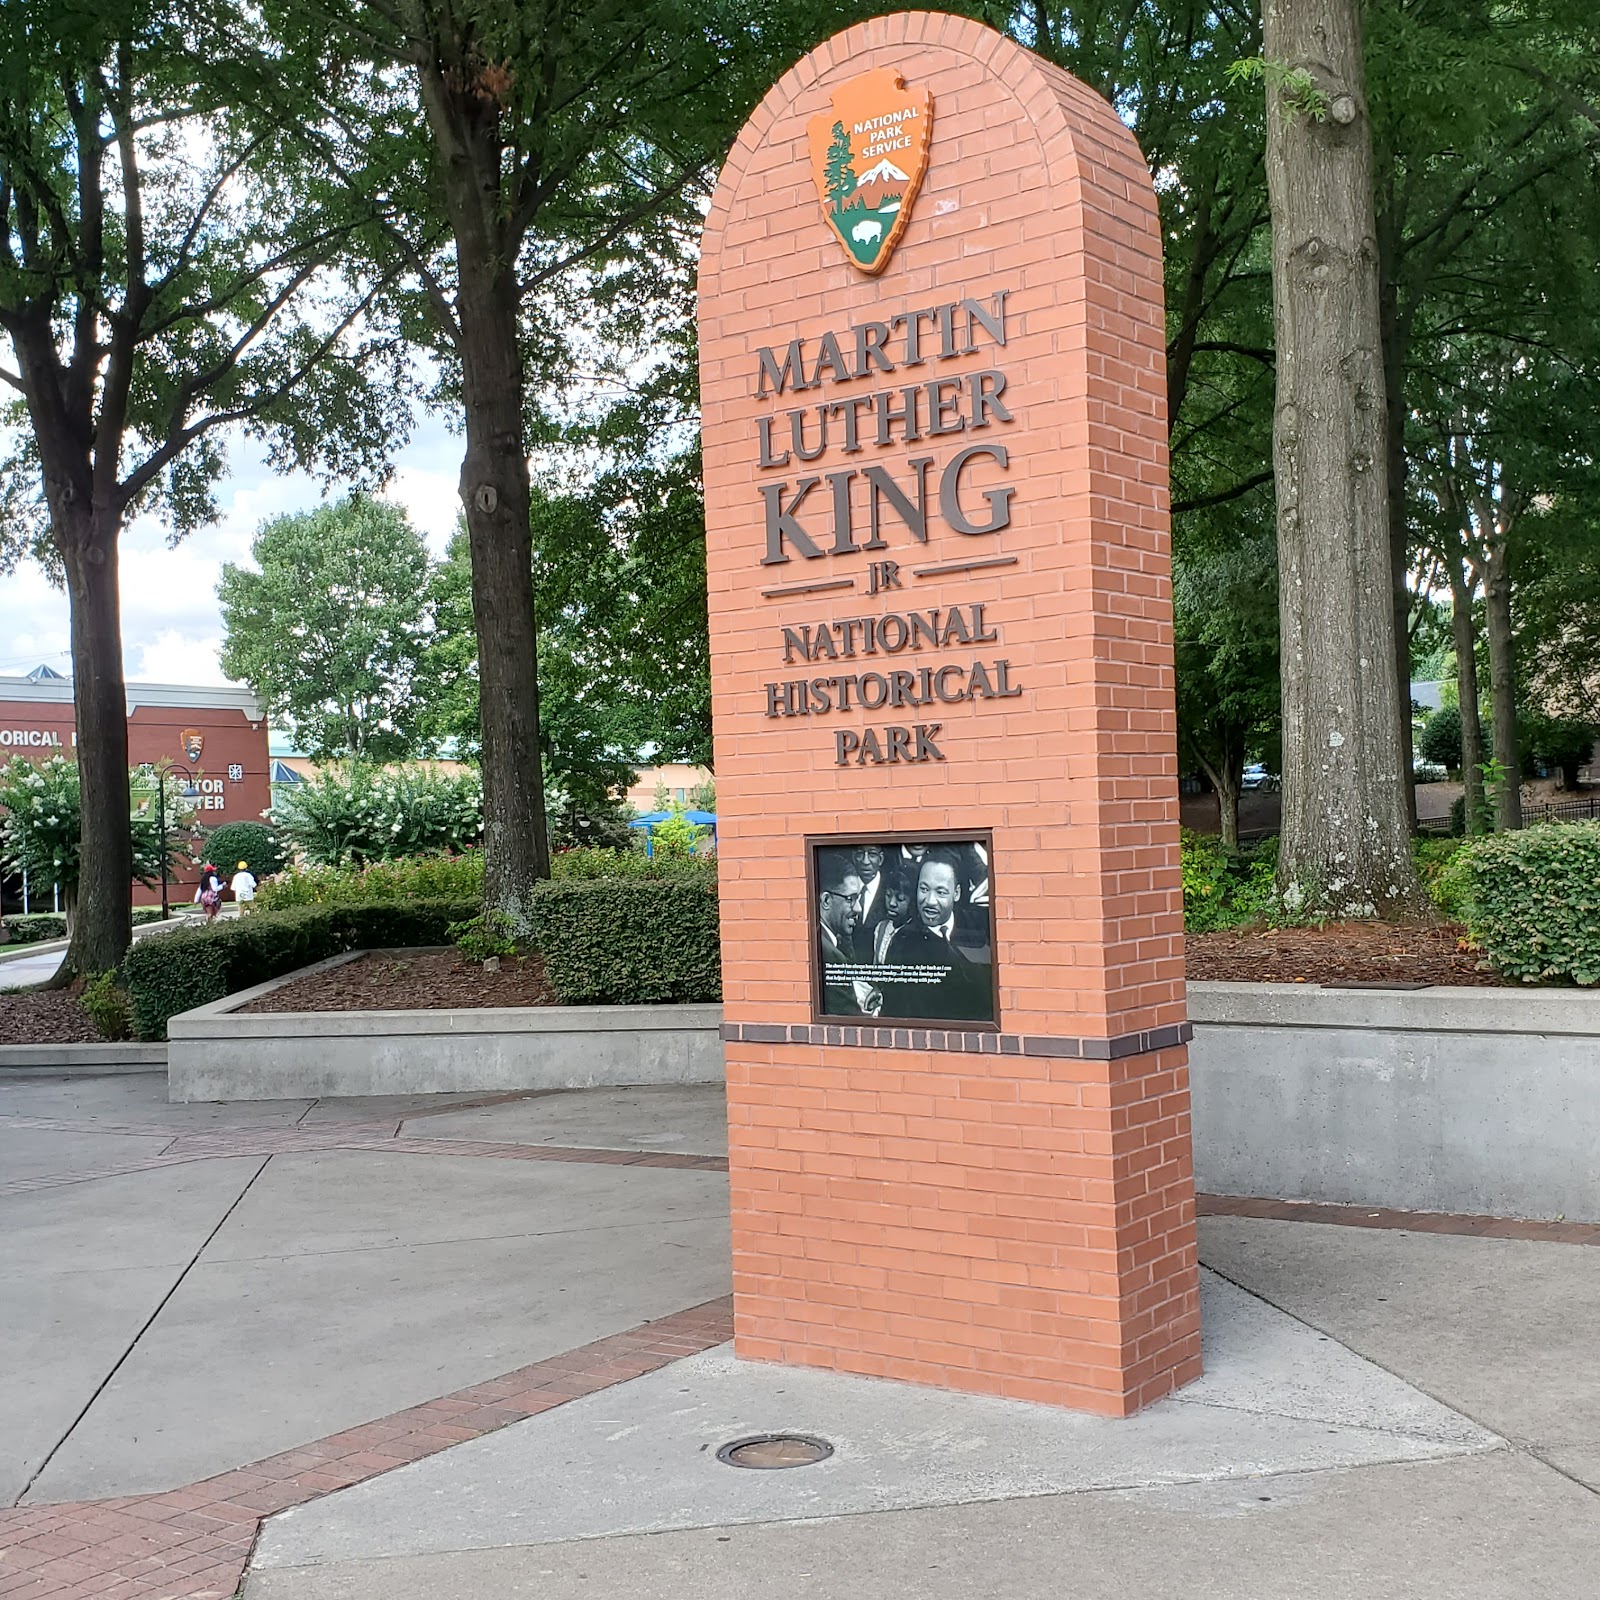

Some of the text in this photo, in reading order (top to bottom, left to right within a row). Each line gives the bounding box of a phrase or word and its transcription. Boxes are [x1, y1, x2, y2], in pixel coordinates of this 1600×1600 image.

[854, 107, 919, 135] NATIONAL
[870, 124, 903, 143] PARK
[862, 135, 912, 159] SERVICE
[754, 288, 1010, 399] MARTIN
[755, 369, 1014, 468] LUTHER
[758, 444, 1015, 565] KING
[865, 560, 902, 596] JR
[781, 603, 998, 663] NATIONAL
[764, 659, 1022, 718] HISTORICAL
[0, 730, 63, 746] ORICAL
[834, 723, 945, 765] PARK
